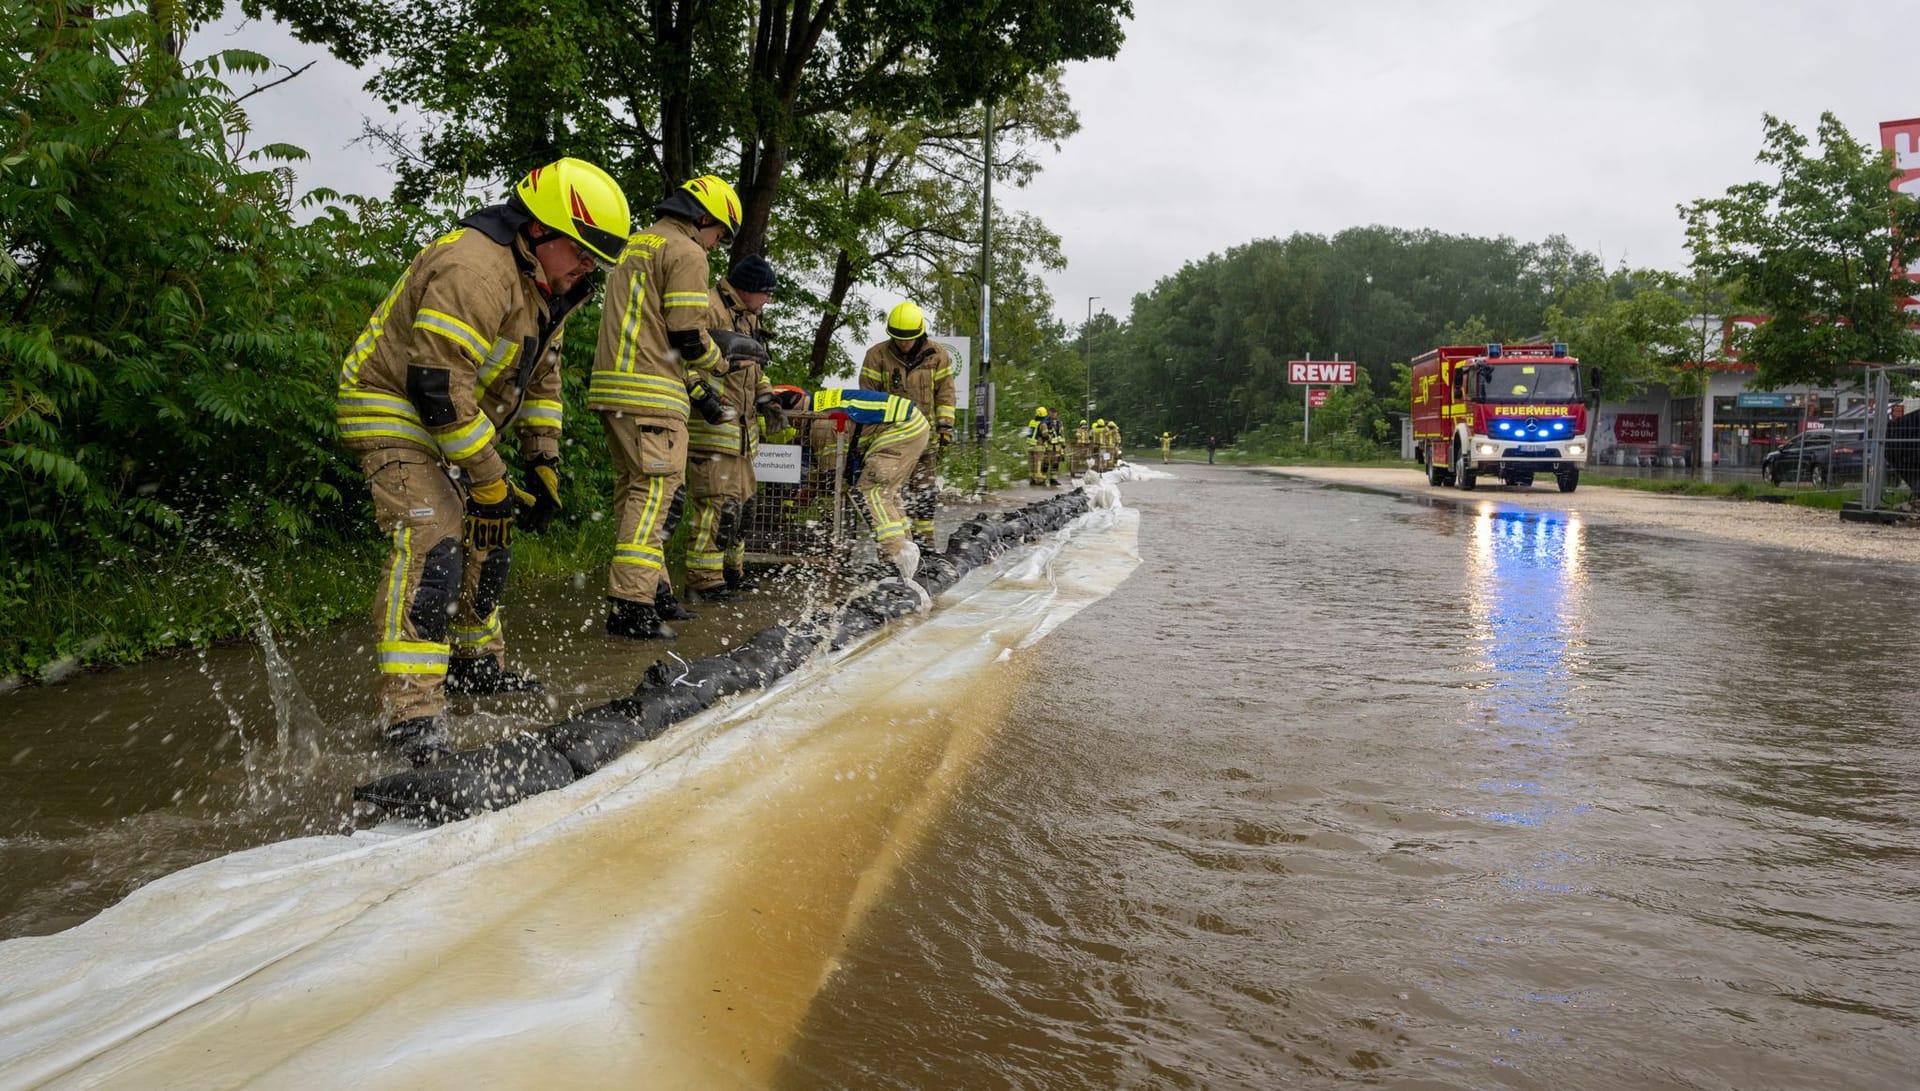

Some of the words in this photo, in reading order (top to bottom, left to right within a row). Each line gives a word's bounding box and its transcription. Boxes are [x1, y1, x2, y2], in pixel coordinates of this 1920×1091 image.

[1292, 364, 1352, 382] REWE
[1495, 406, 1569, 416] FEUERWEHR
[1640, 430, 1655, 438] Uhr
[758, 450, 792, 458] euerwehr
